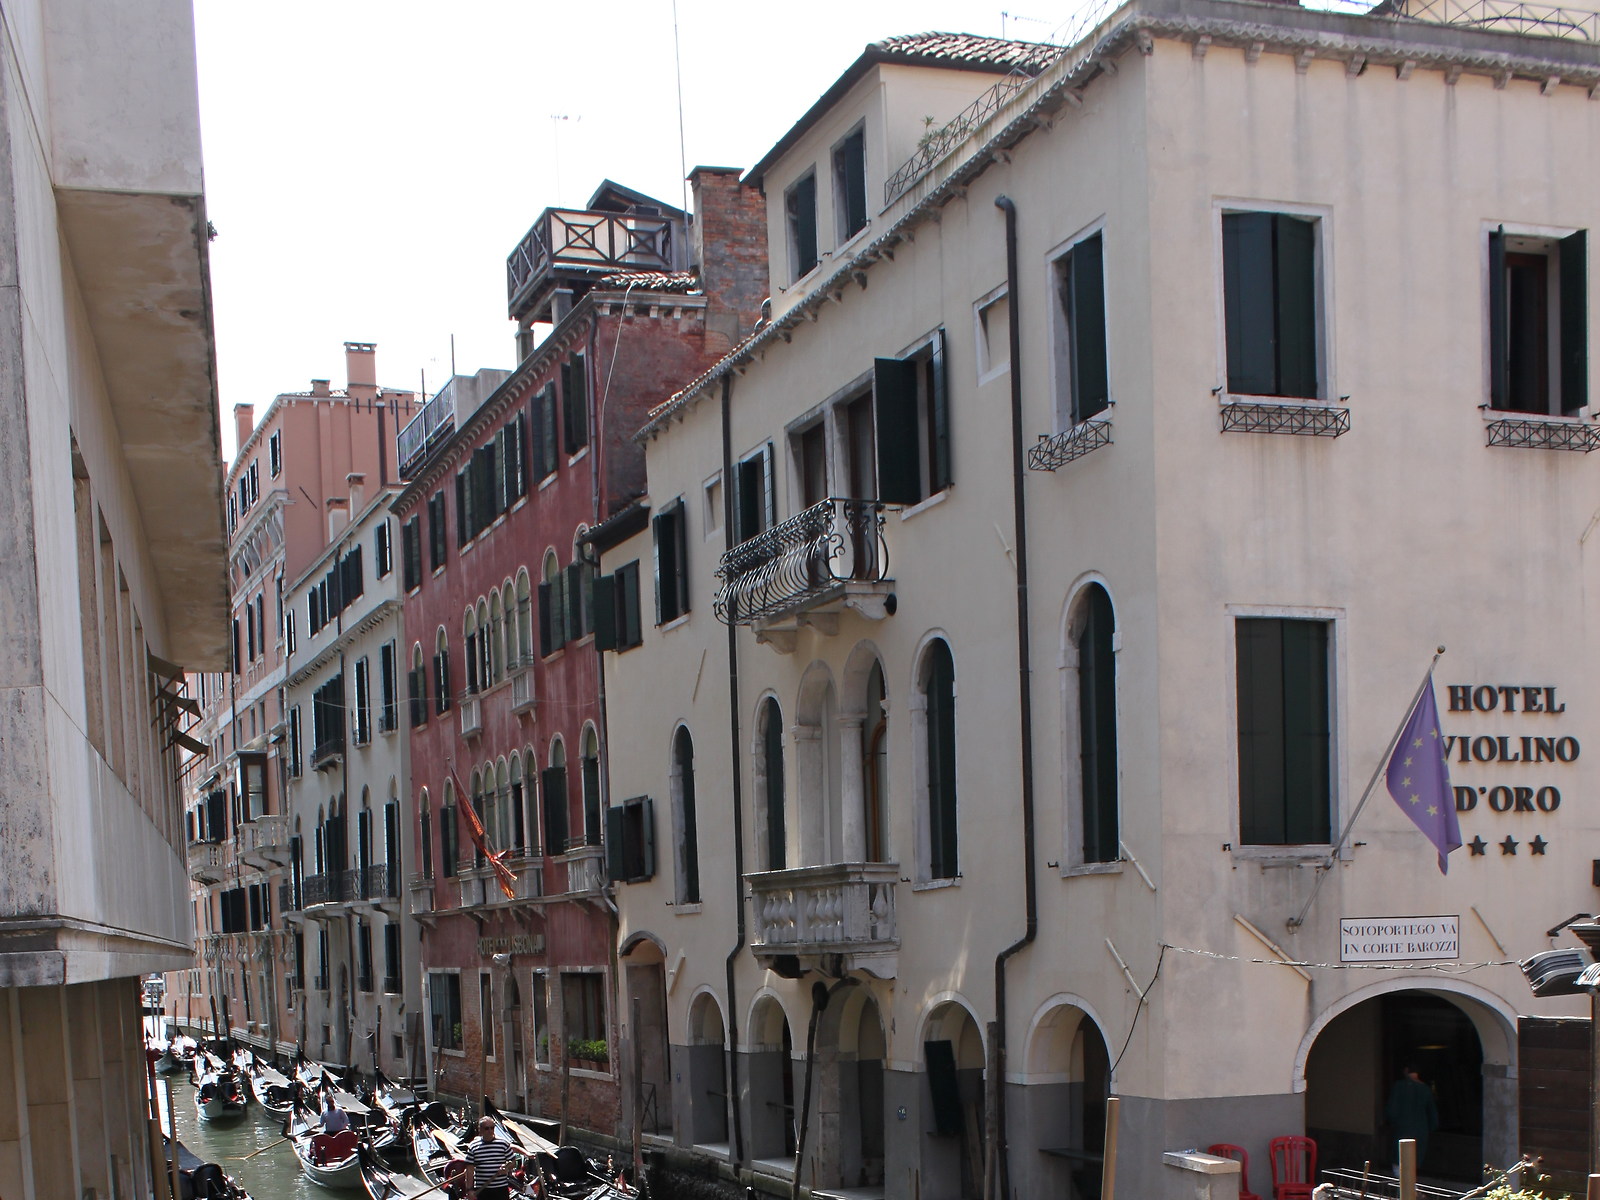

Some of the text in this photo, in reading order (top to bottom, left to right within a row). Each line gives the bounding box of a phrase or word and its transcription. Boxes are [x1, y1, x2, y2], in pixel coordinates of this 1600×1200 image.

[1447, 685, 1566, 713] HOTEL
[1442, 735, 1580, 762] VIOLINO
[1453, 785, 1561, 812] D'ORO
[1343, 923, 1457, 936] SOTOPORTEGO VA
[1344, 940, 1456, 954] IN CORTE BAROZZI
